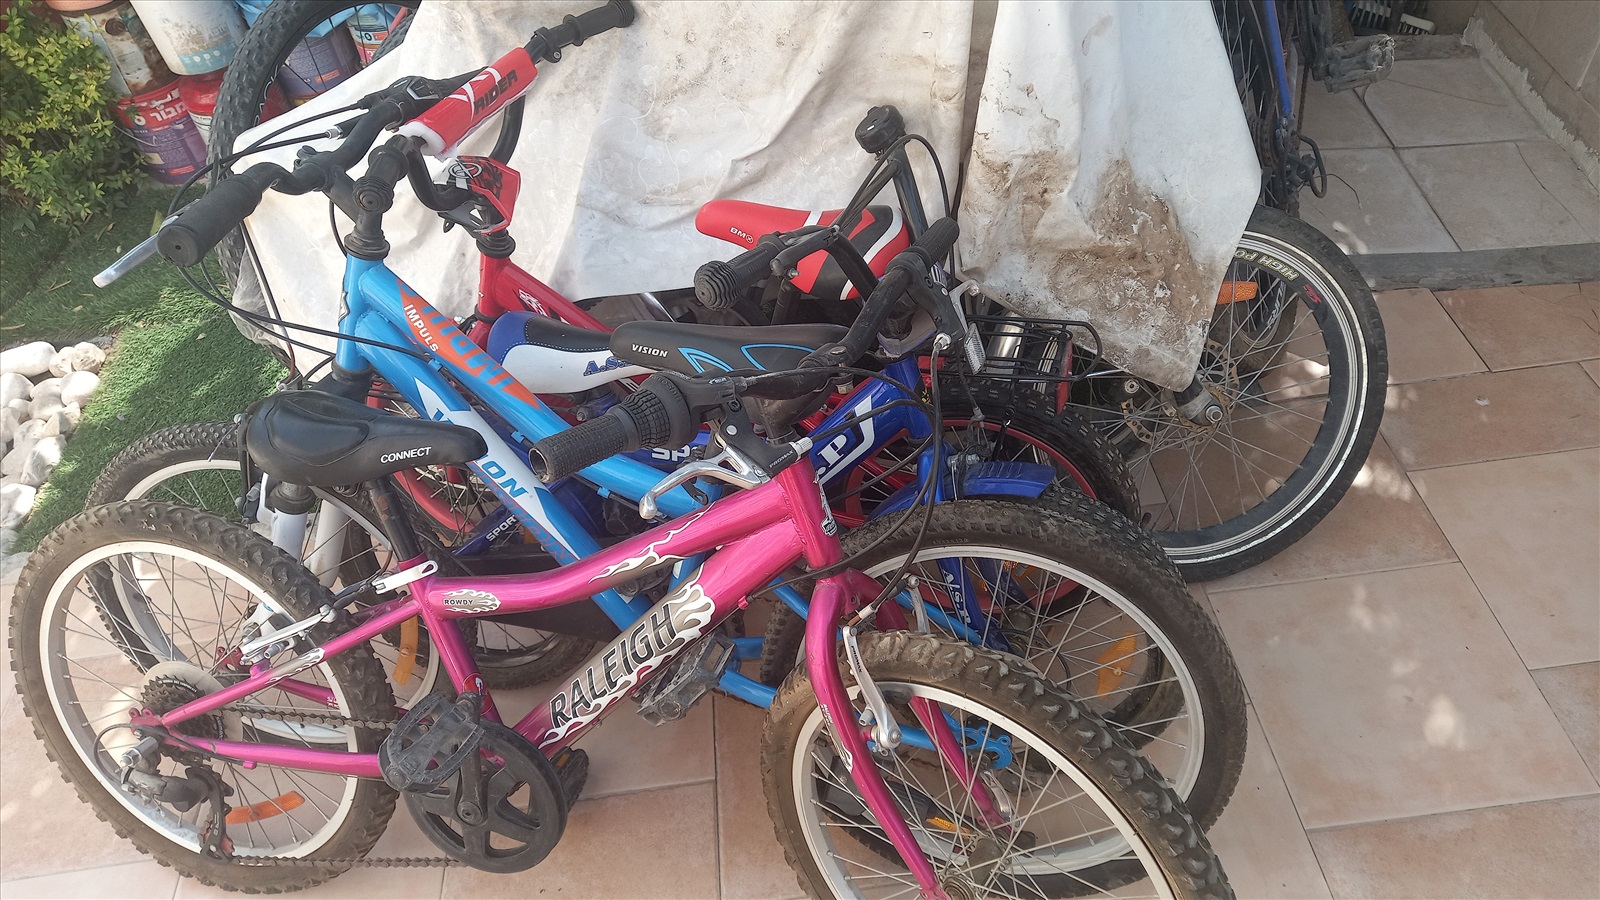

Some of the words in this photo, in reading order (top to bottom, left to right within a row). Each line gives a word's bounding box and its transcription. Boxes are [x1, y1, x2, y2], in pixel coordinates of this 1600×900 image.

[473, 69, 518, 115] RIDER
[1257, 255, 1300, 281] HIGH
[403, 303, 439, 353] IMPULS
[631, 343, 668, 358] VISION
[380, 446, 432, 464] CONNECT
[550, 603, 678, 729] RALEIGH
